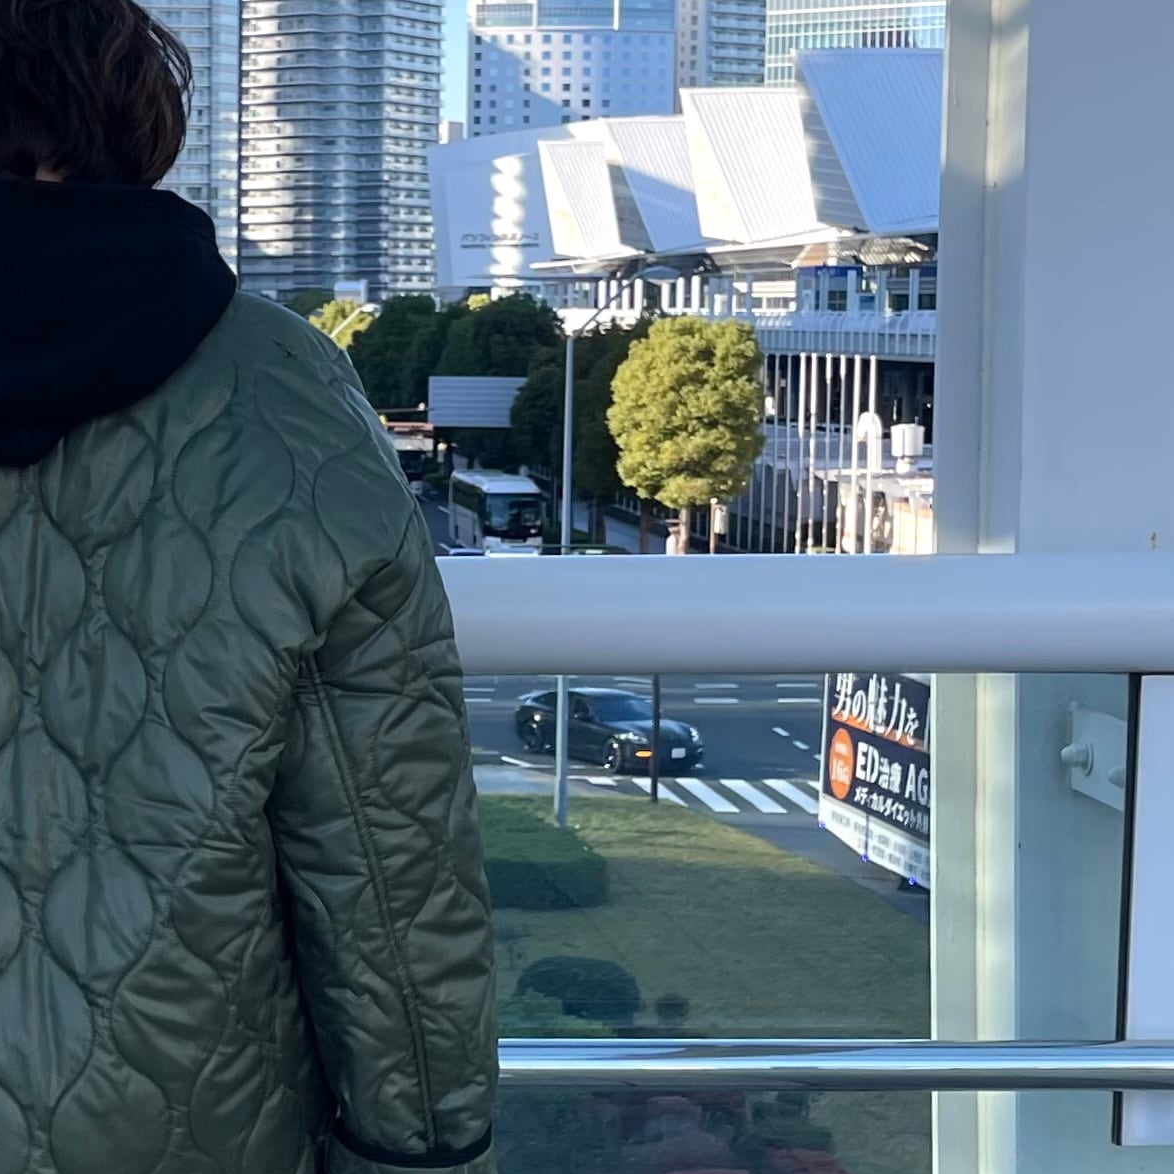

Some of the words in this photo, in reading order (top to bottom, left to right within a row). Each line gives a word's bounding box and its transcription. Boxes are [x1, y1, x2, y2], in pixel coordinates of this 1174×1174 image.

[831, 673, 920, 746] 男の魅力を
[904, 763, 930, 807] AG
